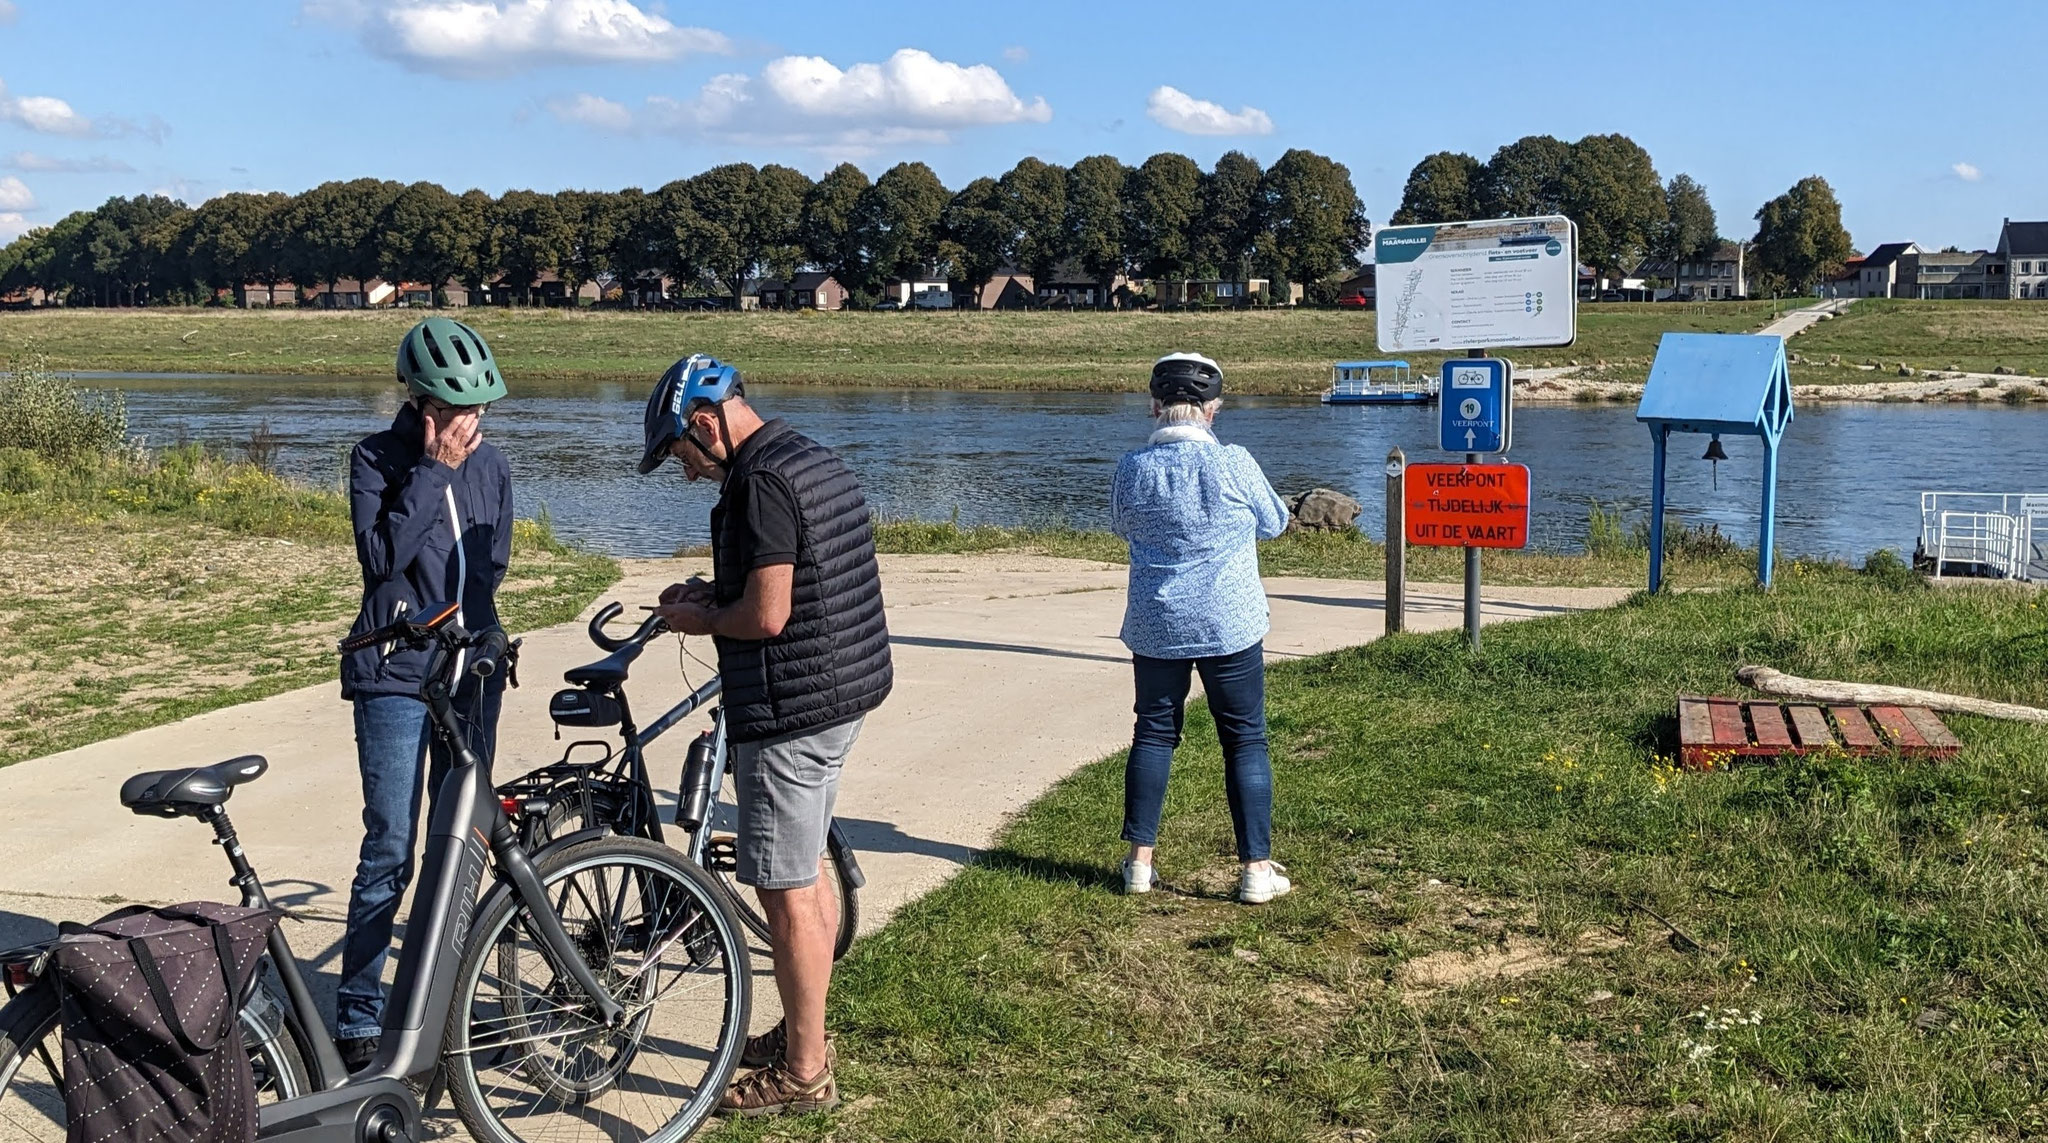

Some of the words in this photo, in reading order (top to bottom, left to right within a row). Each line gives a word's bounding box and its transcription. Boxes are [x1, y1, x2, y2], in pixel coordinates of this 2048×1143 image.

[672, 381, 685, 415] BELL
[1464, 403, 1475, 414] 19
[1426, 473, 1506, 487] VEERPONT
[1427, 498, 1504, 514] TIJDELIJK
[1416, 523, 1438, 538] UIT
[1443, 524, 1462, 539] DE
[1467, 525, 1517, 541] VAART
